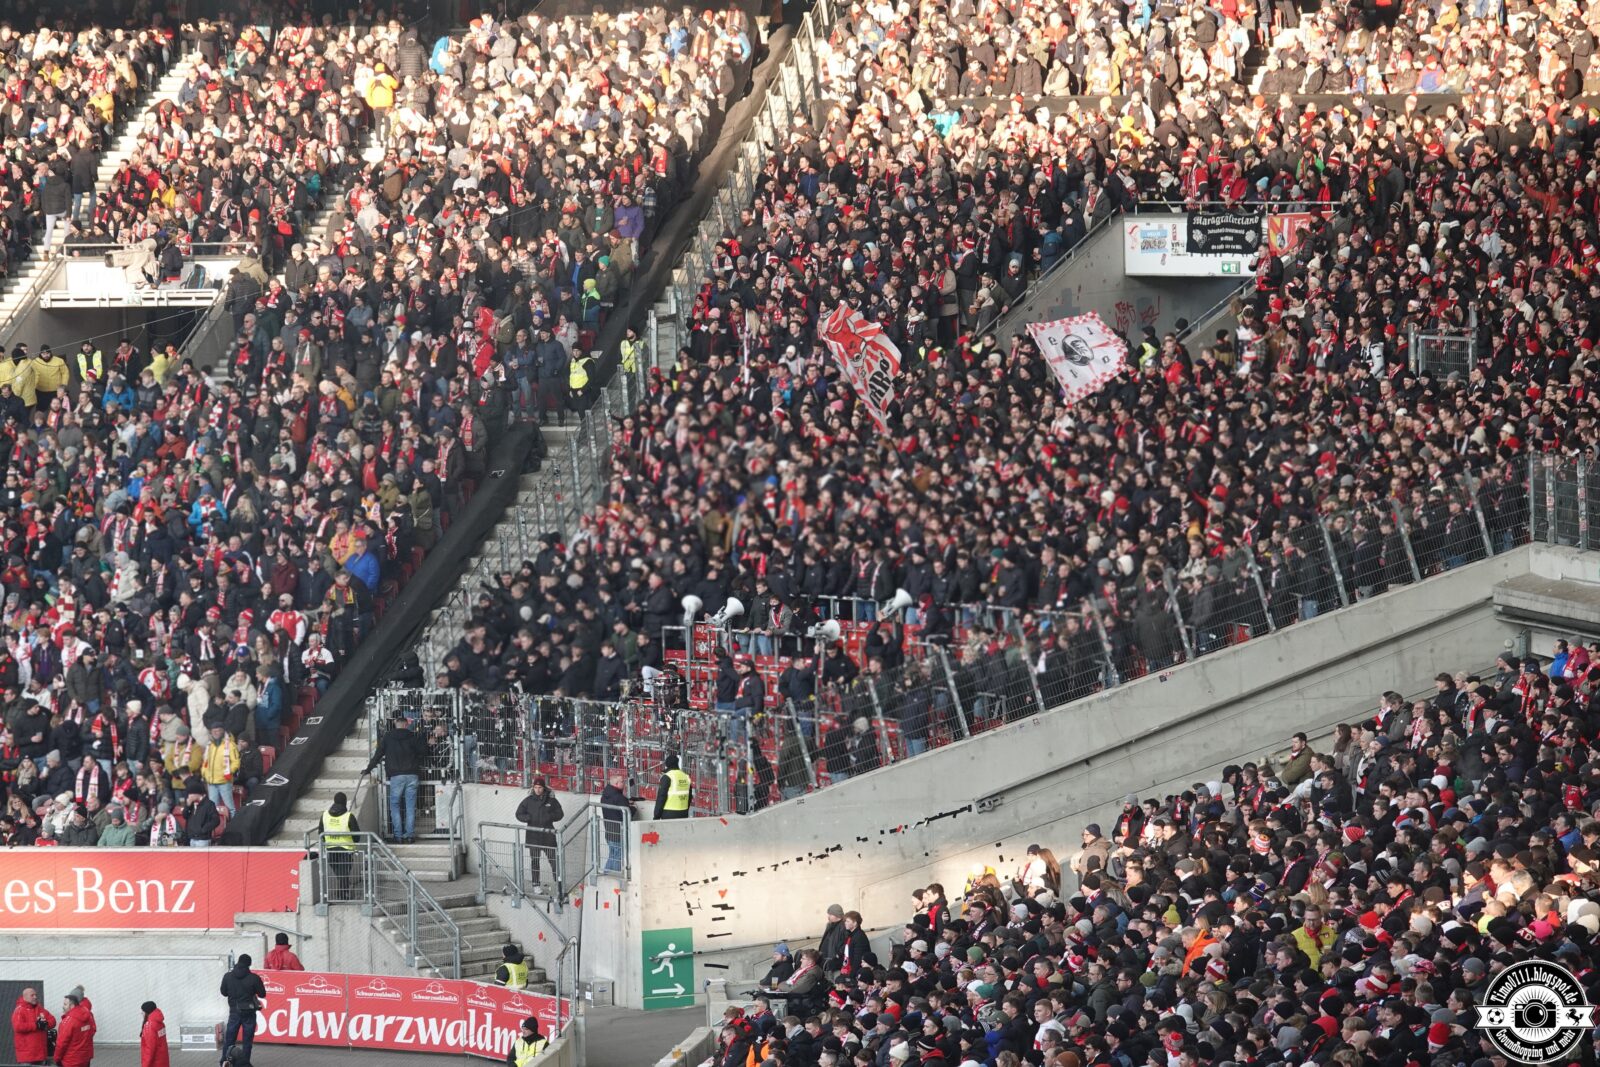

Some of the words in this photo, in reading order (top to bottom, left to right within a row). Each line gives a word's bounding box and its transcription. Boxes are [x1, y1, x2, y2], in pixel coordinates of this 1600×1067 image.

[0, 867, 196, 914] es-Benz
[296, 986, 341, 996] Schwarzwaldmilch
[356, 990, 401, 999] Schwarzwaldmilch
[413, 993, 458, 1002] Schwarzwaldmilch
